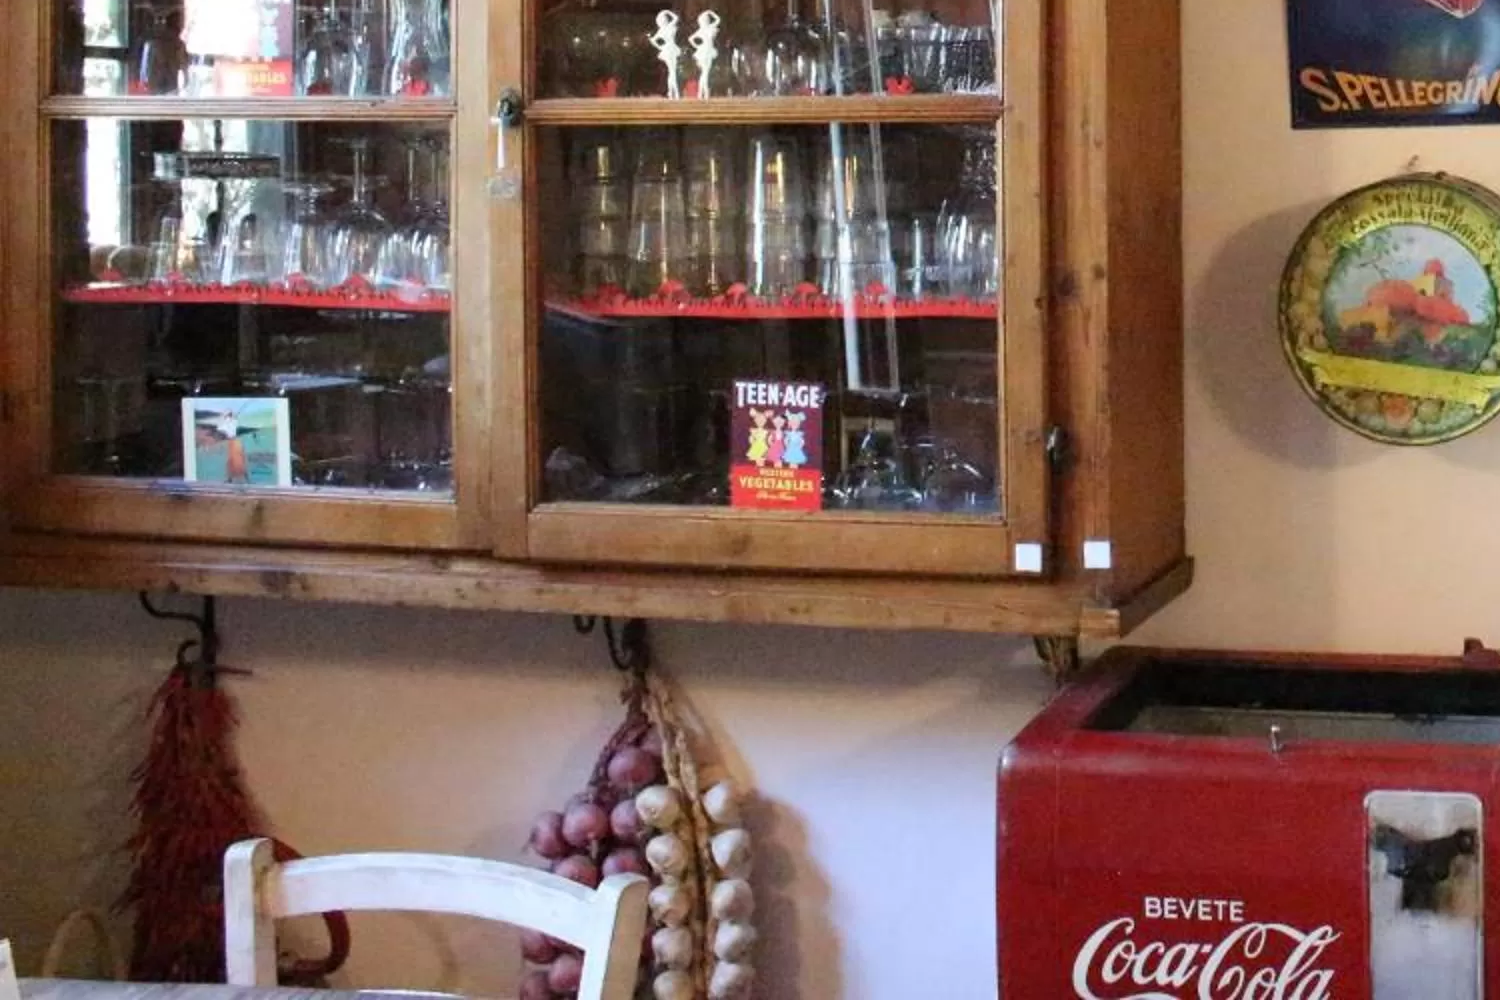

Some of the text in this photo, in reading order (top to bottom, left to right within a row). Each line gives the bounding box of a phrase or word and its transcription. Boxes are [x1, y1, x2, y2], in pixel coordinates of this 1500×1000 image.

[740, 476, 814, 492] VEGETABLES
[1144, 896, 1244, 923] BEVETE
[1071, 917, 1341, 1000] Coca-Cola
